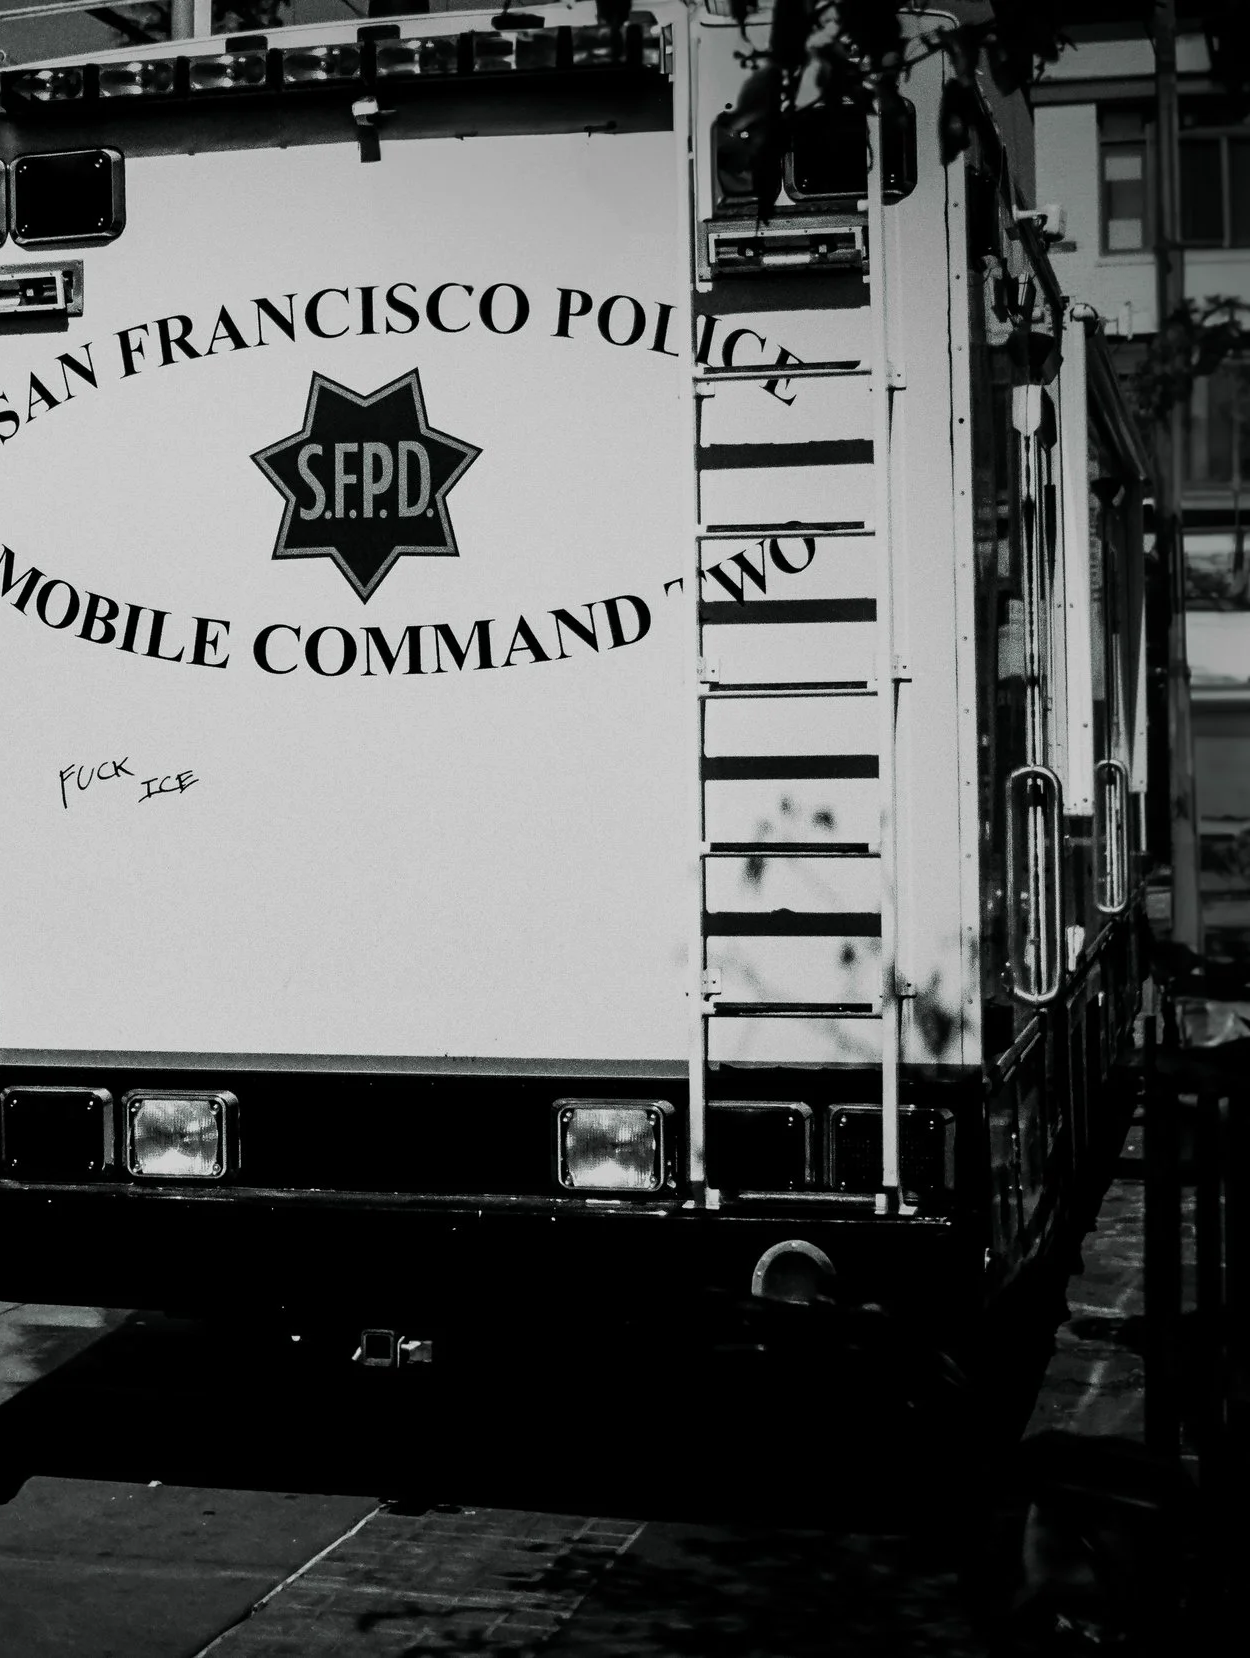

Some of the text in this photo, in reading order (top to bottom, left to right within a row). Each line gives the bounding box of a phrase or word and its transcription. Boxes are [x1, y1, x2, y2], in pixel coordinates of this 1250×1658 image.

[114, 283, 529, 378] FRANCISCO
[553, 288, 805, 406] POLICE
[298, 440, 434, 521] S.F.P.D.
[254, 595, 651, 676] COMMAND
[59, 757, 200, 809] FUCK ICE
